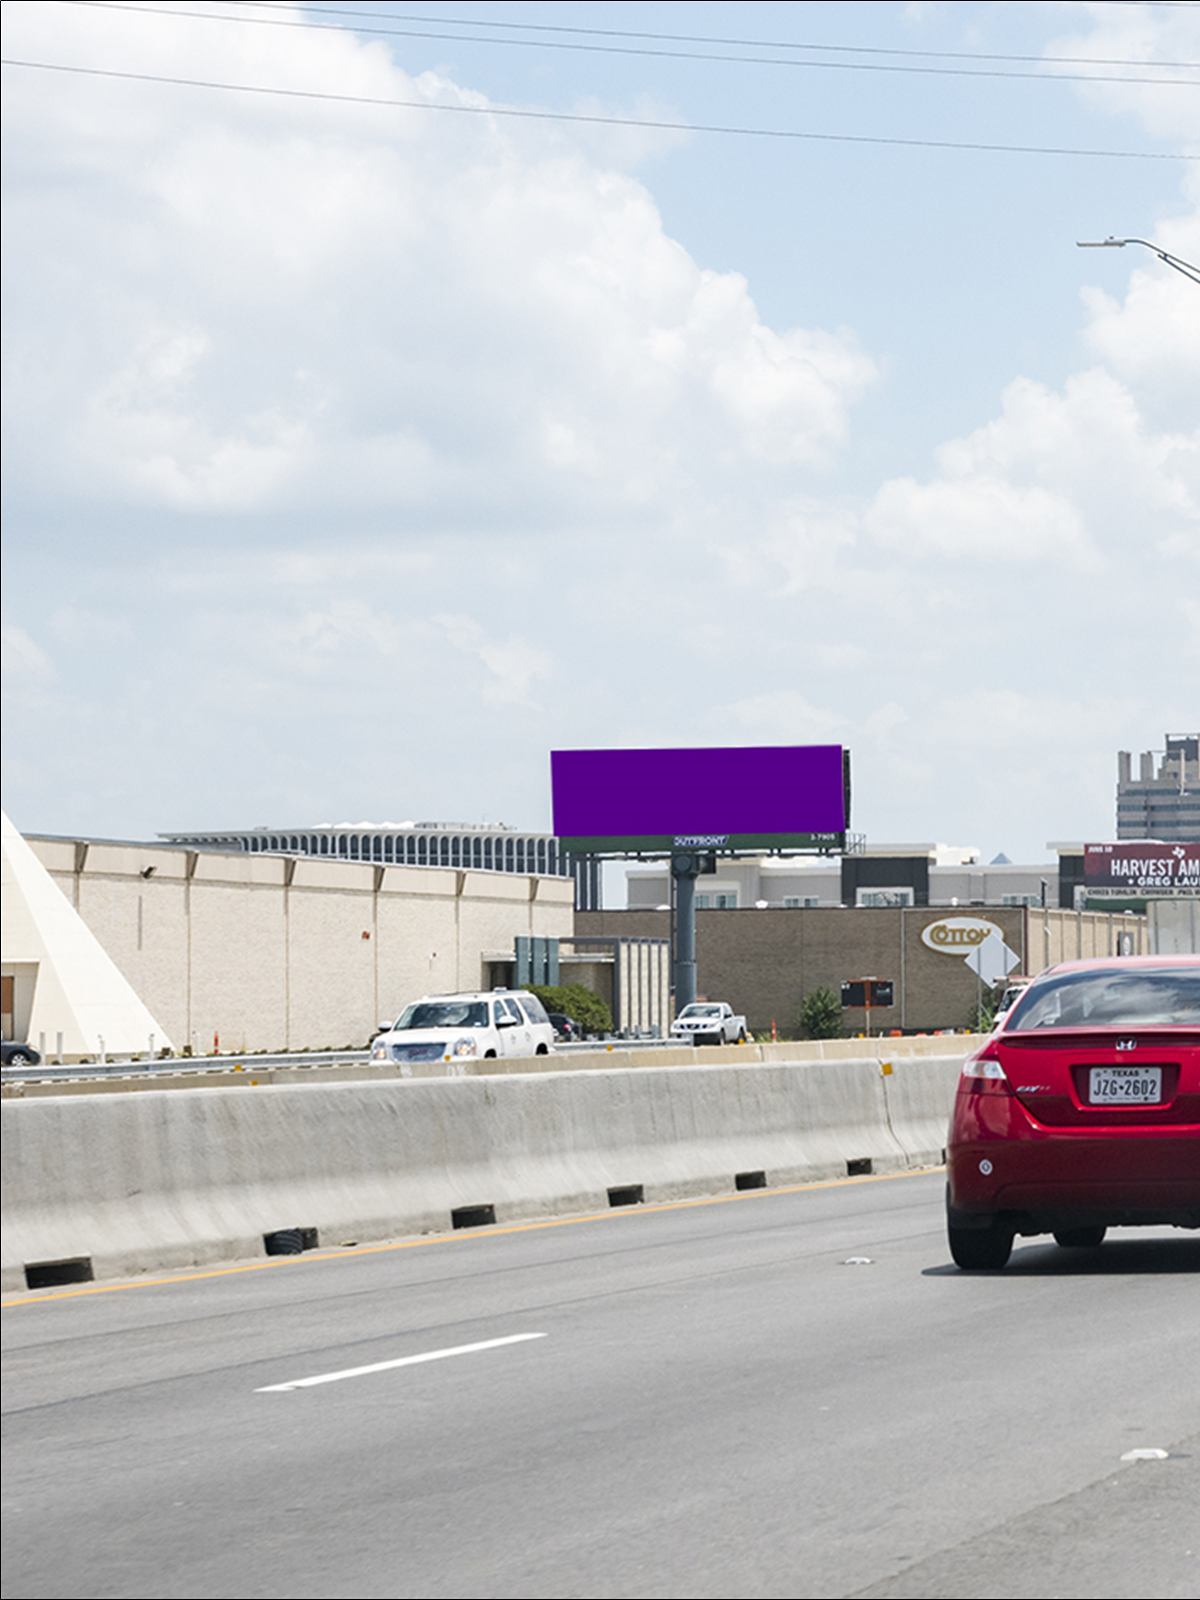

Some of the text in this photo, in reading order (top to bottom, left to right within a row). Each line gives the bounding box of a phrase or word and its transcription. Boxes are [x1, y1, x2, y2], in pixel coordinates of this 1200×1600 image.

[673, 836, 727, 846] OUTFRONT
[1111, 859, 1174, 876] HARVEST
[1137, 877, 1171, 886] GREG
[1112, 1069, 1139, 1077] TEXAS
